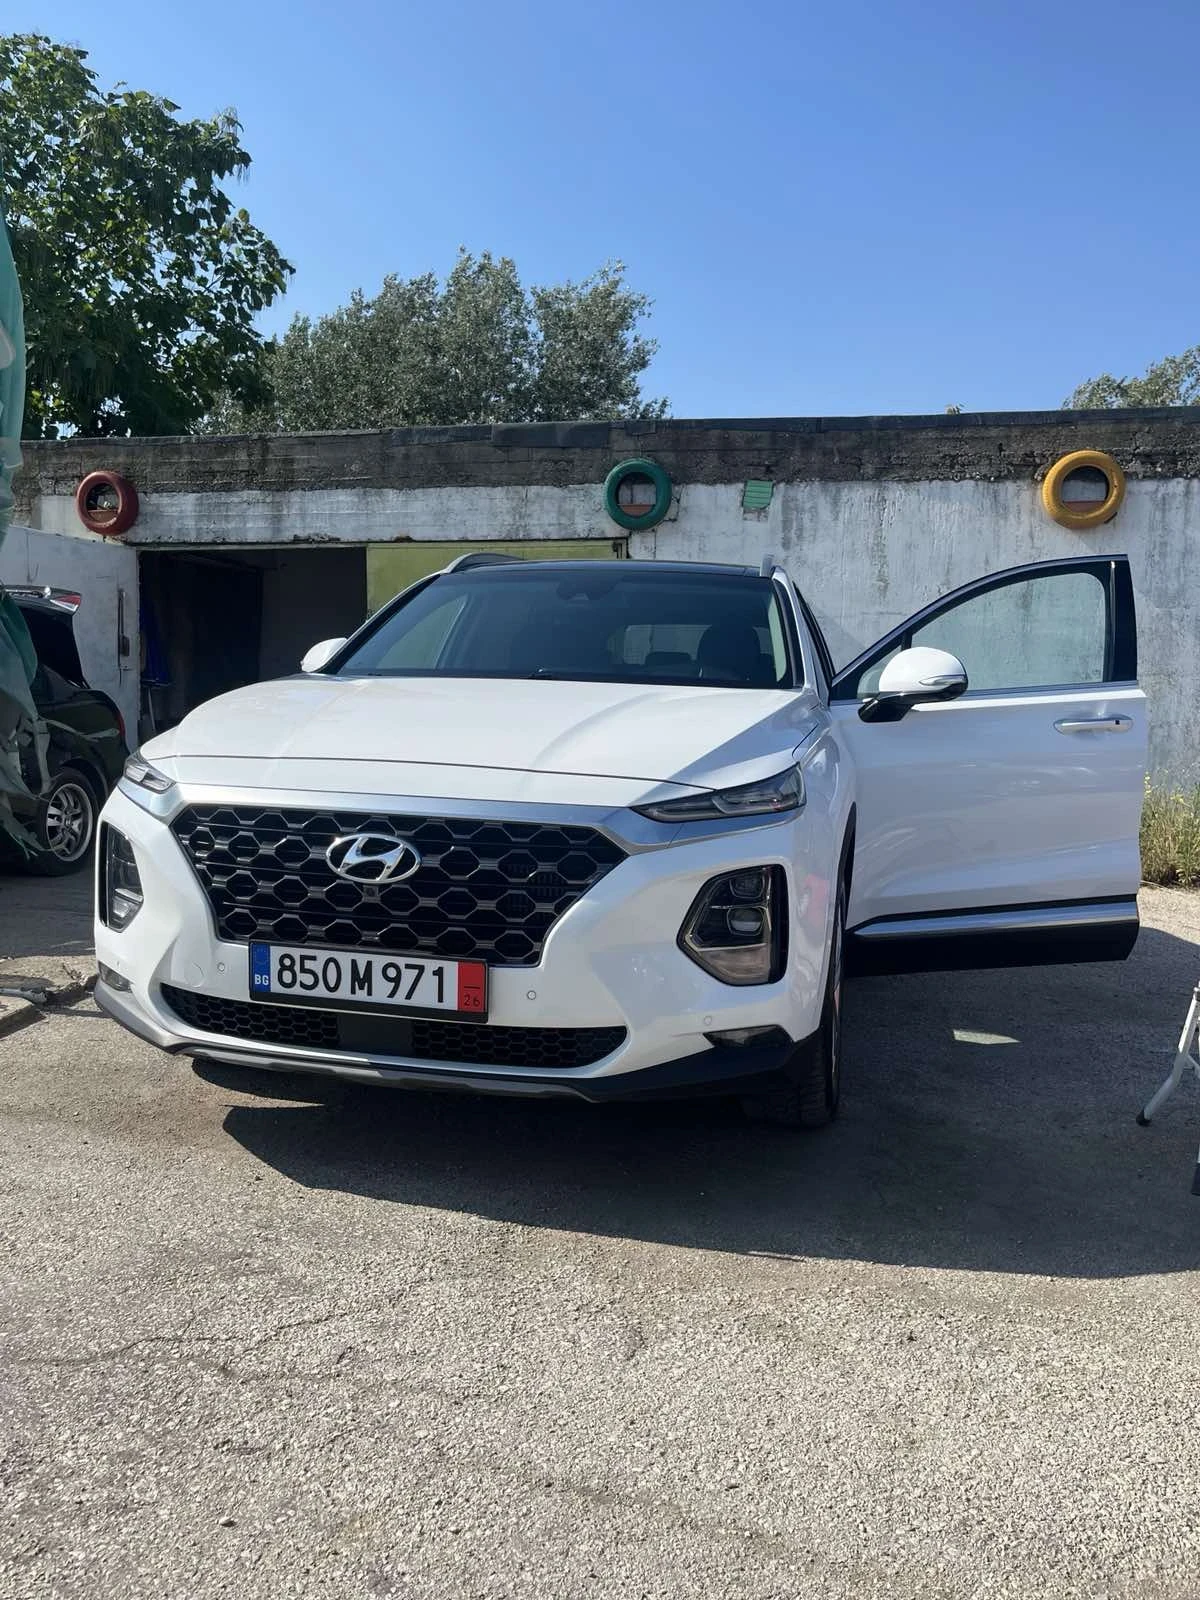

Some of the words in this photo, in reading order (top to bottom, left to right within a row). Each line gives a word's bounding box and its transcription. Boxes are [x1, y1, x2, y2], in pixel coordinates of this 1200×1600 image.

[254, 974, 269, 986] BG
[277, 953, 342, 993] 850
[350, 958, 373, 997] M
[381, 962, 444, 1003] 971
[463, 993, 481, 1007] 26
